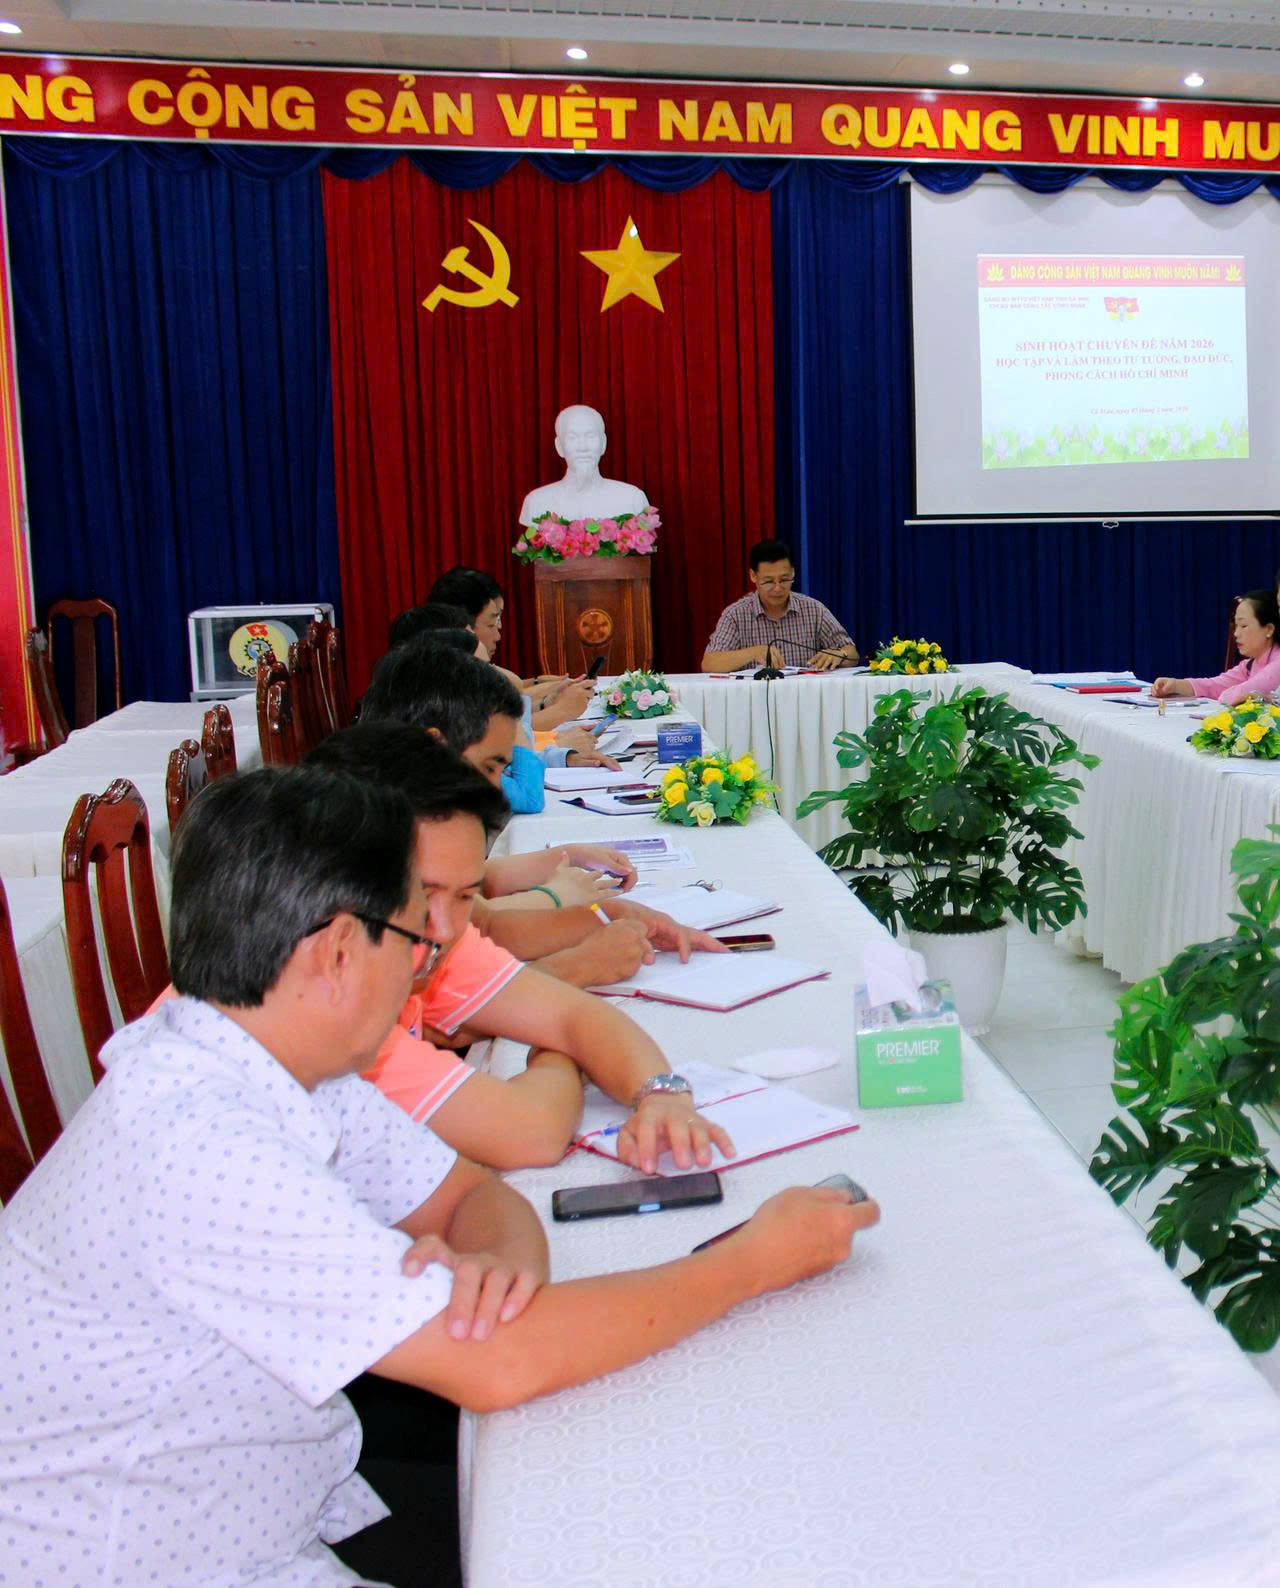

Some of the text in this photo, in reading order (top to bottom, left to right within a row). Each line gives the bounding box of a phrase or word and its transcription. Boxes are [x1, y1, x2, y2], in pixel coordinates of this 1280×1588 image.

[0, 74, 95, 123] NG
[128, 68, 315, 140] CỘNG
[346, 73, 474, 136] SẢN
[497, 84, 637, 153] VIỆT
[659, 100, 793, 144] NAM
[821, 103, 1022, 152] QUANG
[1048, 114, 1180, 158] VINH
[1101, 264, 1120, 280] NAM
[1122, 264, 1152, 281] QUANG
[1016, 341, 1046, 352] SINH
[1049, 340, 1084, 353] HOẠT
[1087, 338, 1139, 351] CHUYÊN
[1160, 337, 1188, 349] NĂM
[1190, 338, 1214, 349] 2026
[996, 357, 1020, 368] HỌC
[1091, 356, 1122, 365] THEO
[1045, 371, 1083, 381] PHONG
[1086, 368, 1118, 380] CÁCH
[1159, 369, 1189, 378] MINH
[665, 735, 695, 745] PREMIER
[876, 1040, 941, 1057] PREMIER
